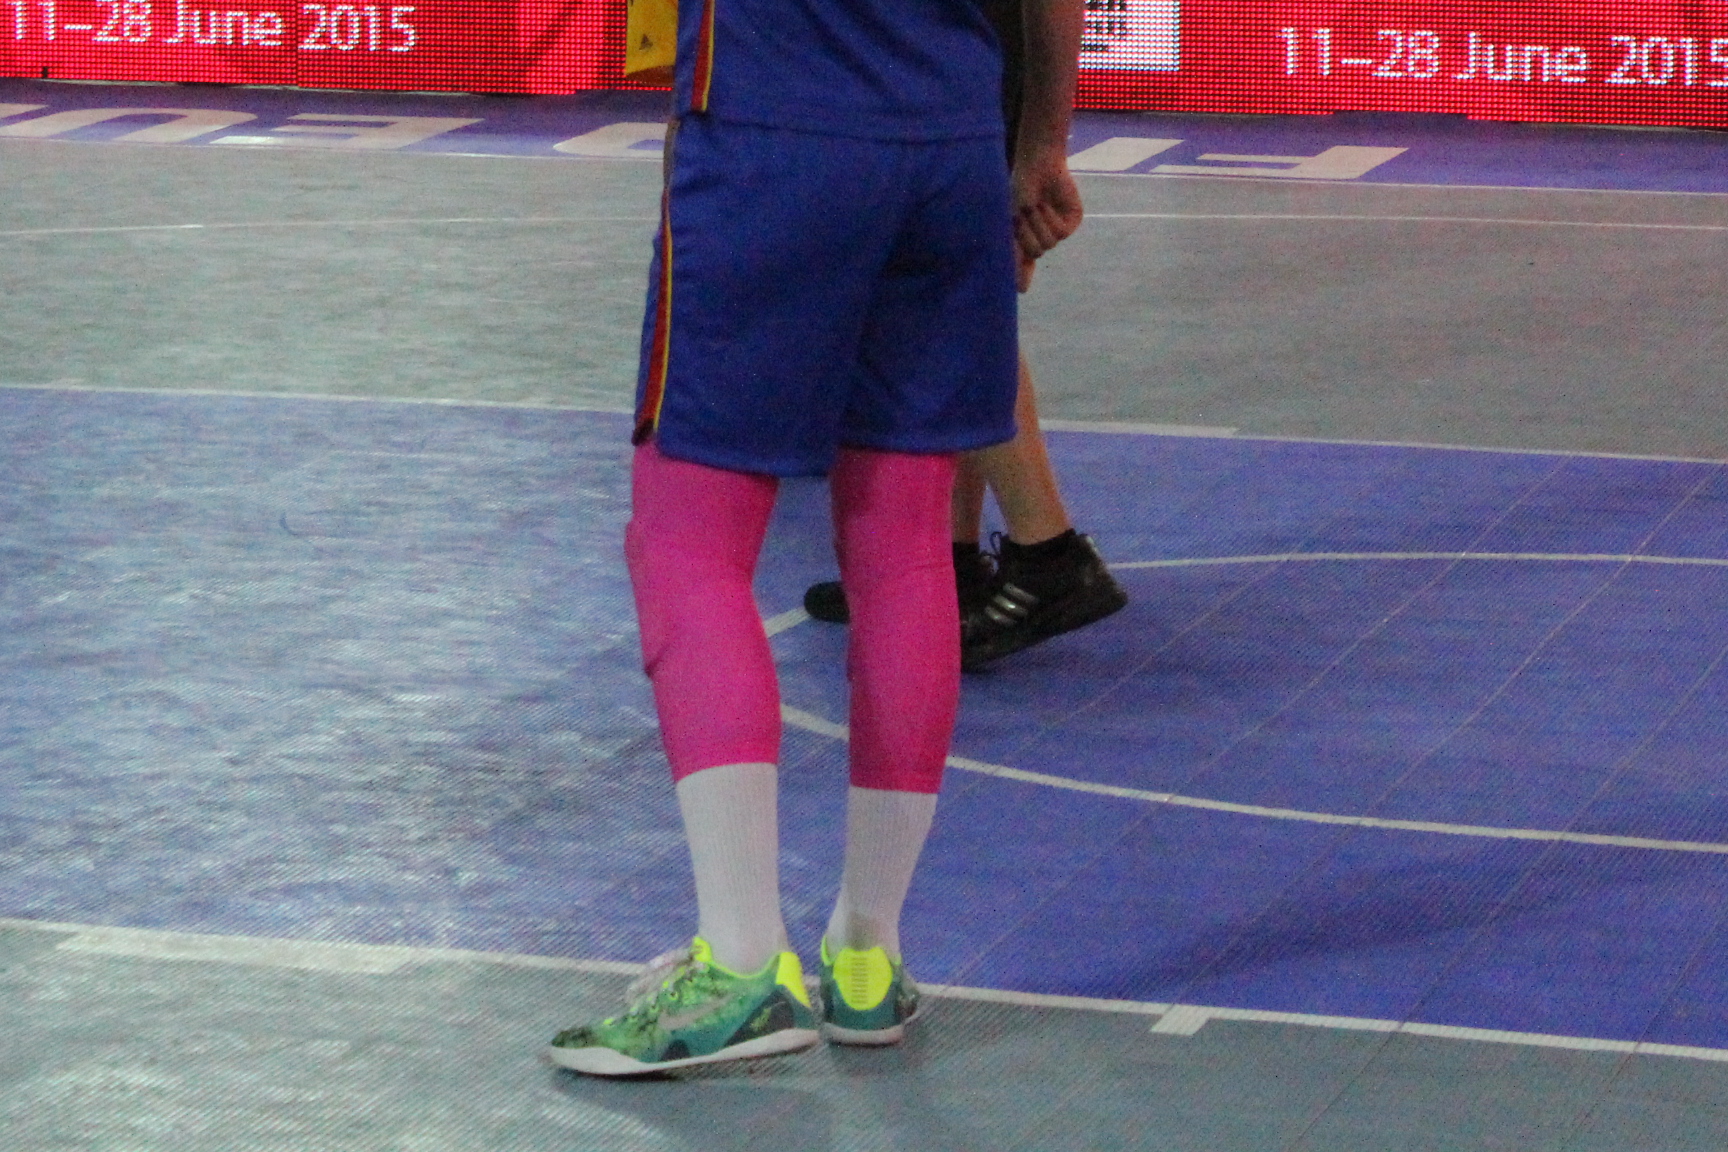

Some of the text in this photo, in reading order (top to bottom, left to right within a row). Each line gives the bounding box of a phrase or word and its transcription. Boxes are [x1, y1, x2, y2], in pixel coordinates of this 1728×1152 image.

[298, 4, 419, 53] 2015
[1456, 30, 1591, 84] June
[1604, 35, 1728, 87] 2015
